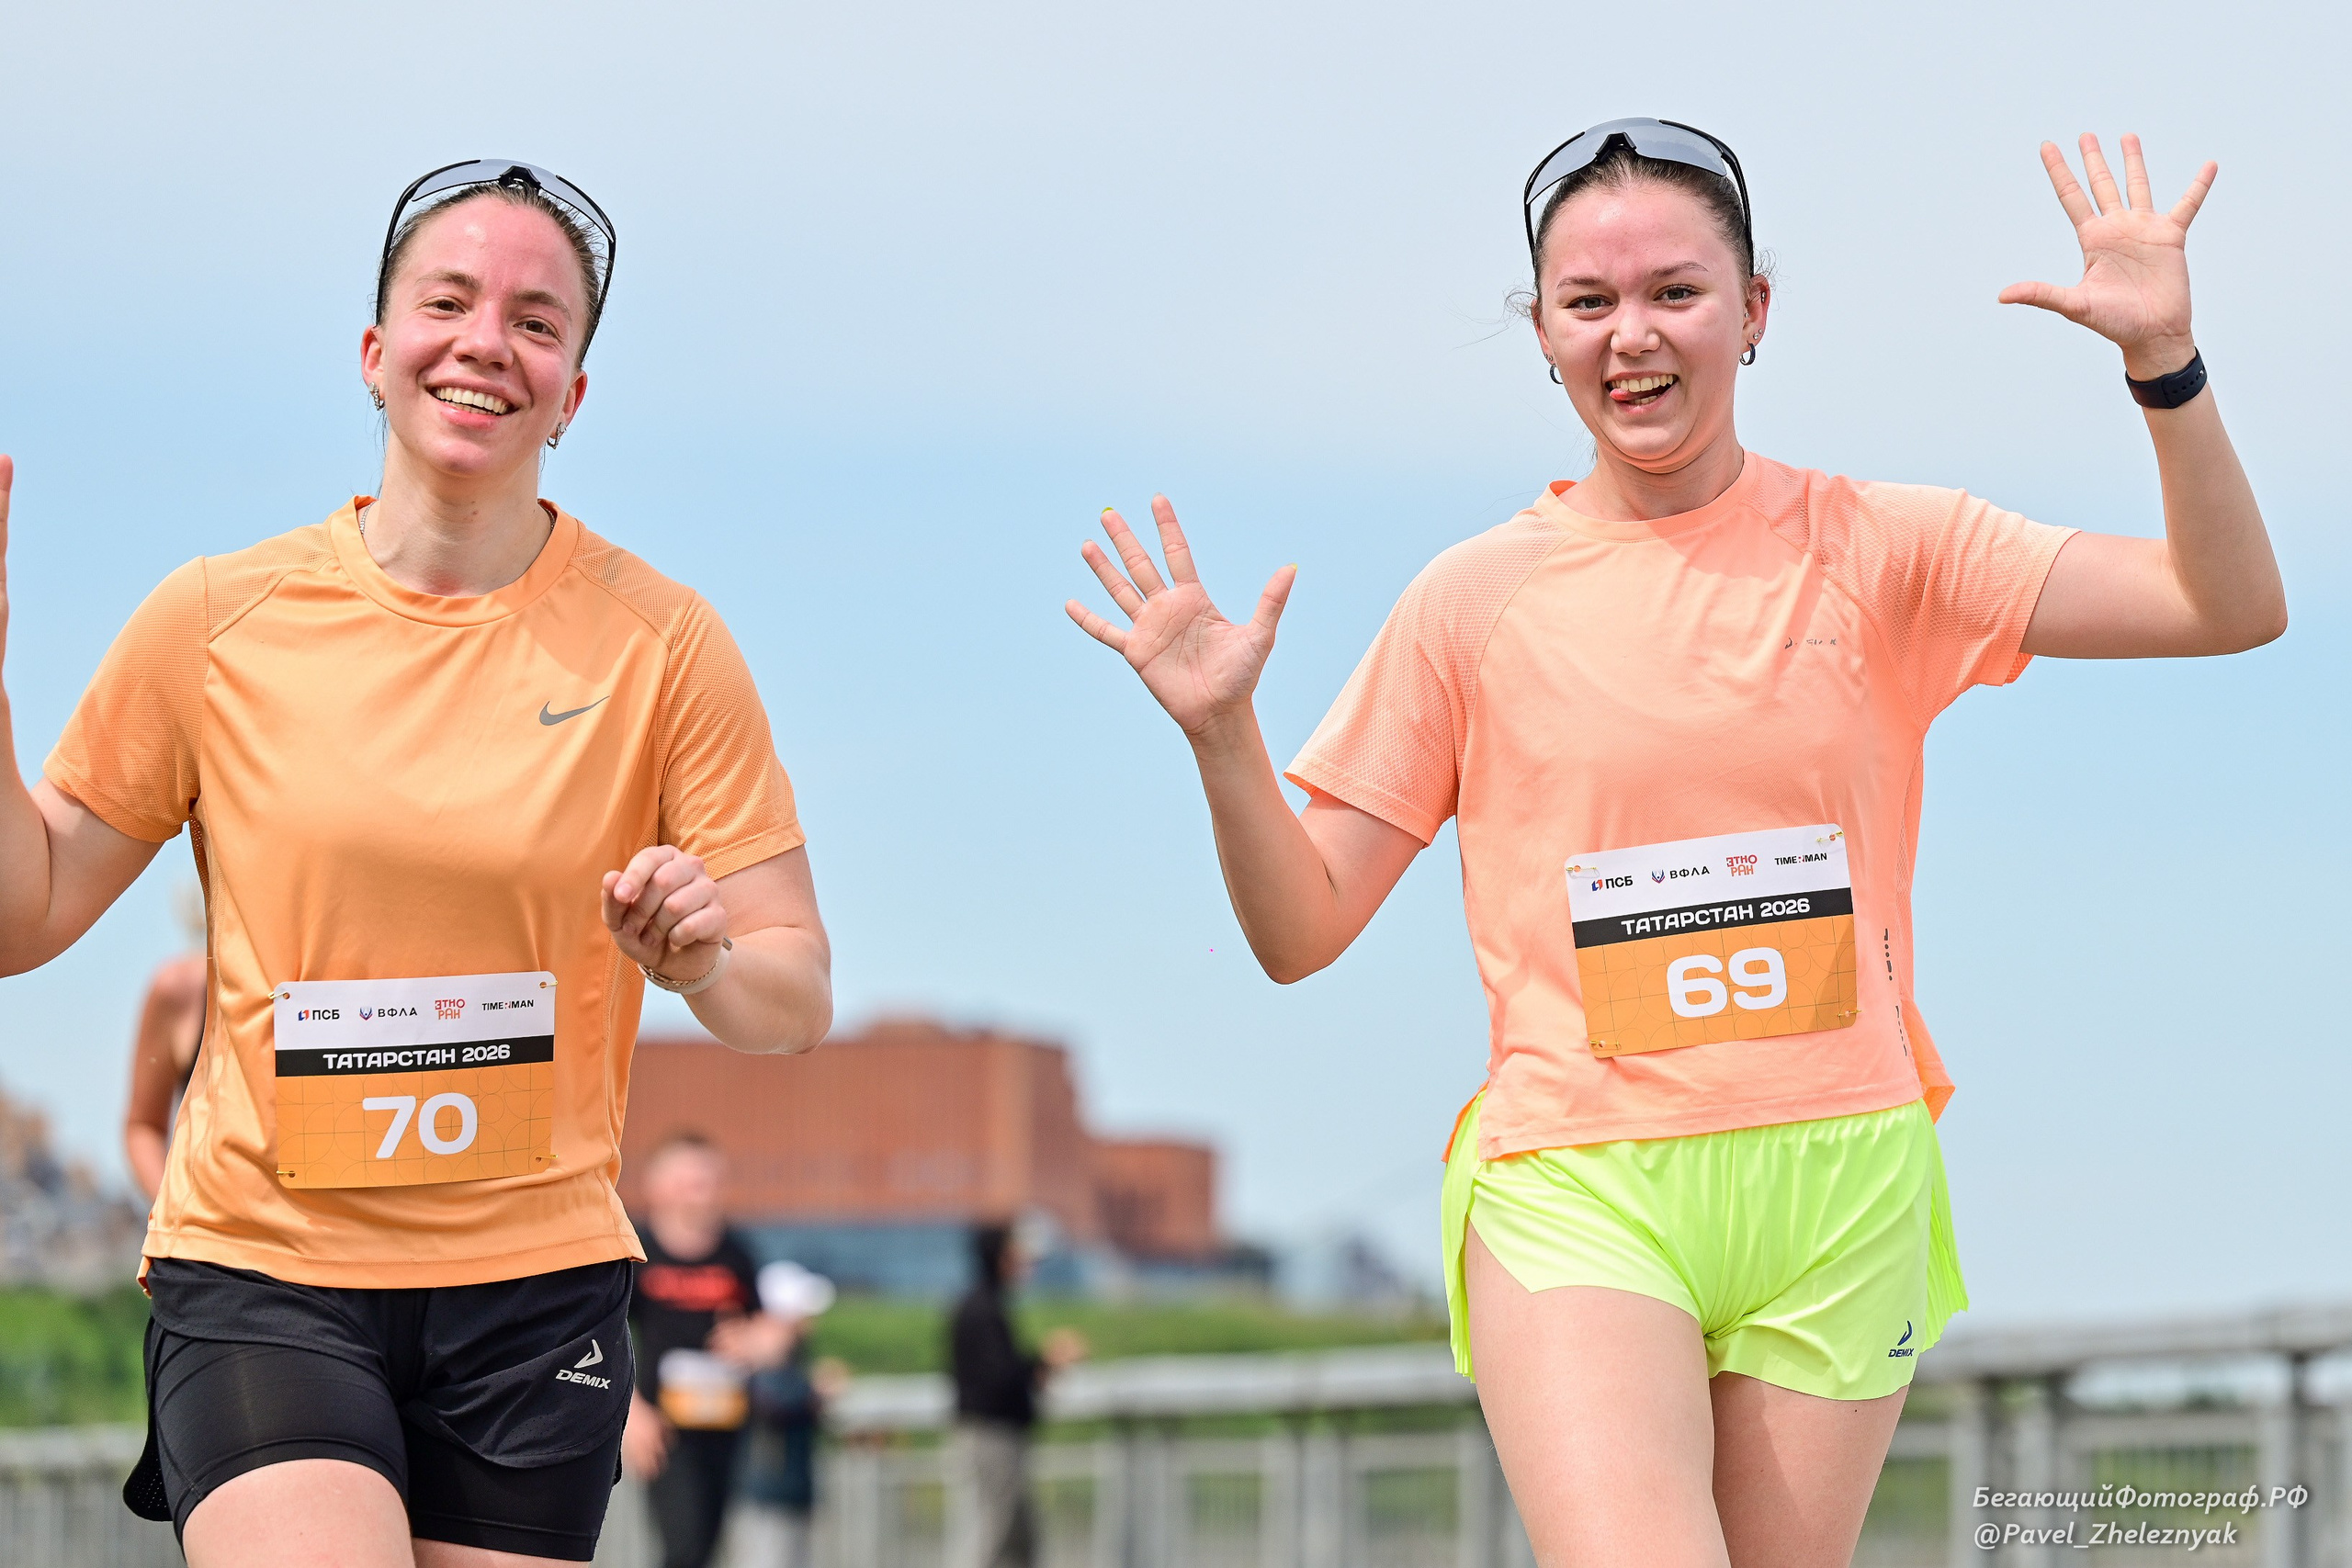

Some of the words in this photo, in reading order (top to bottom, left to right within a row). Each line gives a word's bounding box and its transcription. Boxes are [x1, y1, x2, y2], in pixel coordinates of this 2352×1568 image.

[1669, 865, 1711, 879] ВФЛА
[1605, 875, 1634, 889] ПСБ
[1621, 904, 1754, 935] ТАТАРСТАН
[1759, 897, 1811, 918] 2026
[1666, 946, 1788, 1018] 69
[312, 1009, 340, 1021] ПСБ
[378, 1007, 418, 1018] ВФЛА
[322, 1048, 456, 1069] ТАТАРСТАН
[461, 1043, 511, 1063] 2026
[362, 1092, 478, 1159] 70
[1888, 1348, 1915, 1358] DEMIX
[555, 1369, 612, 1390] DEMIX
